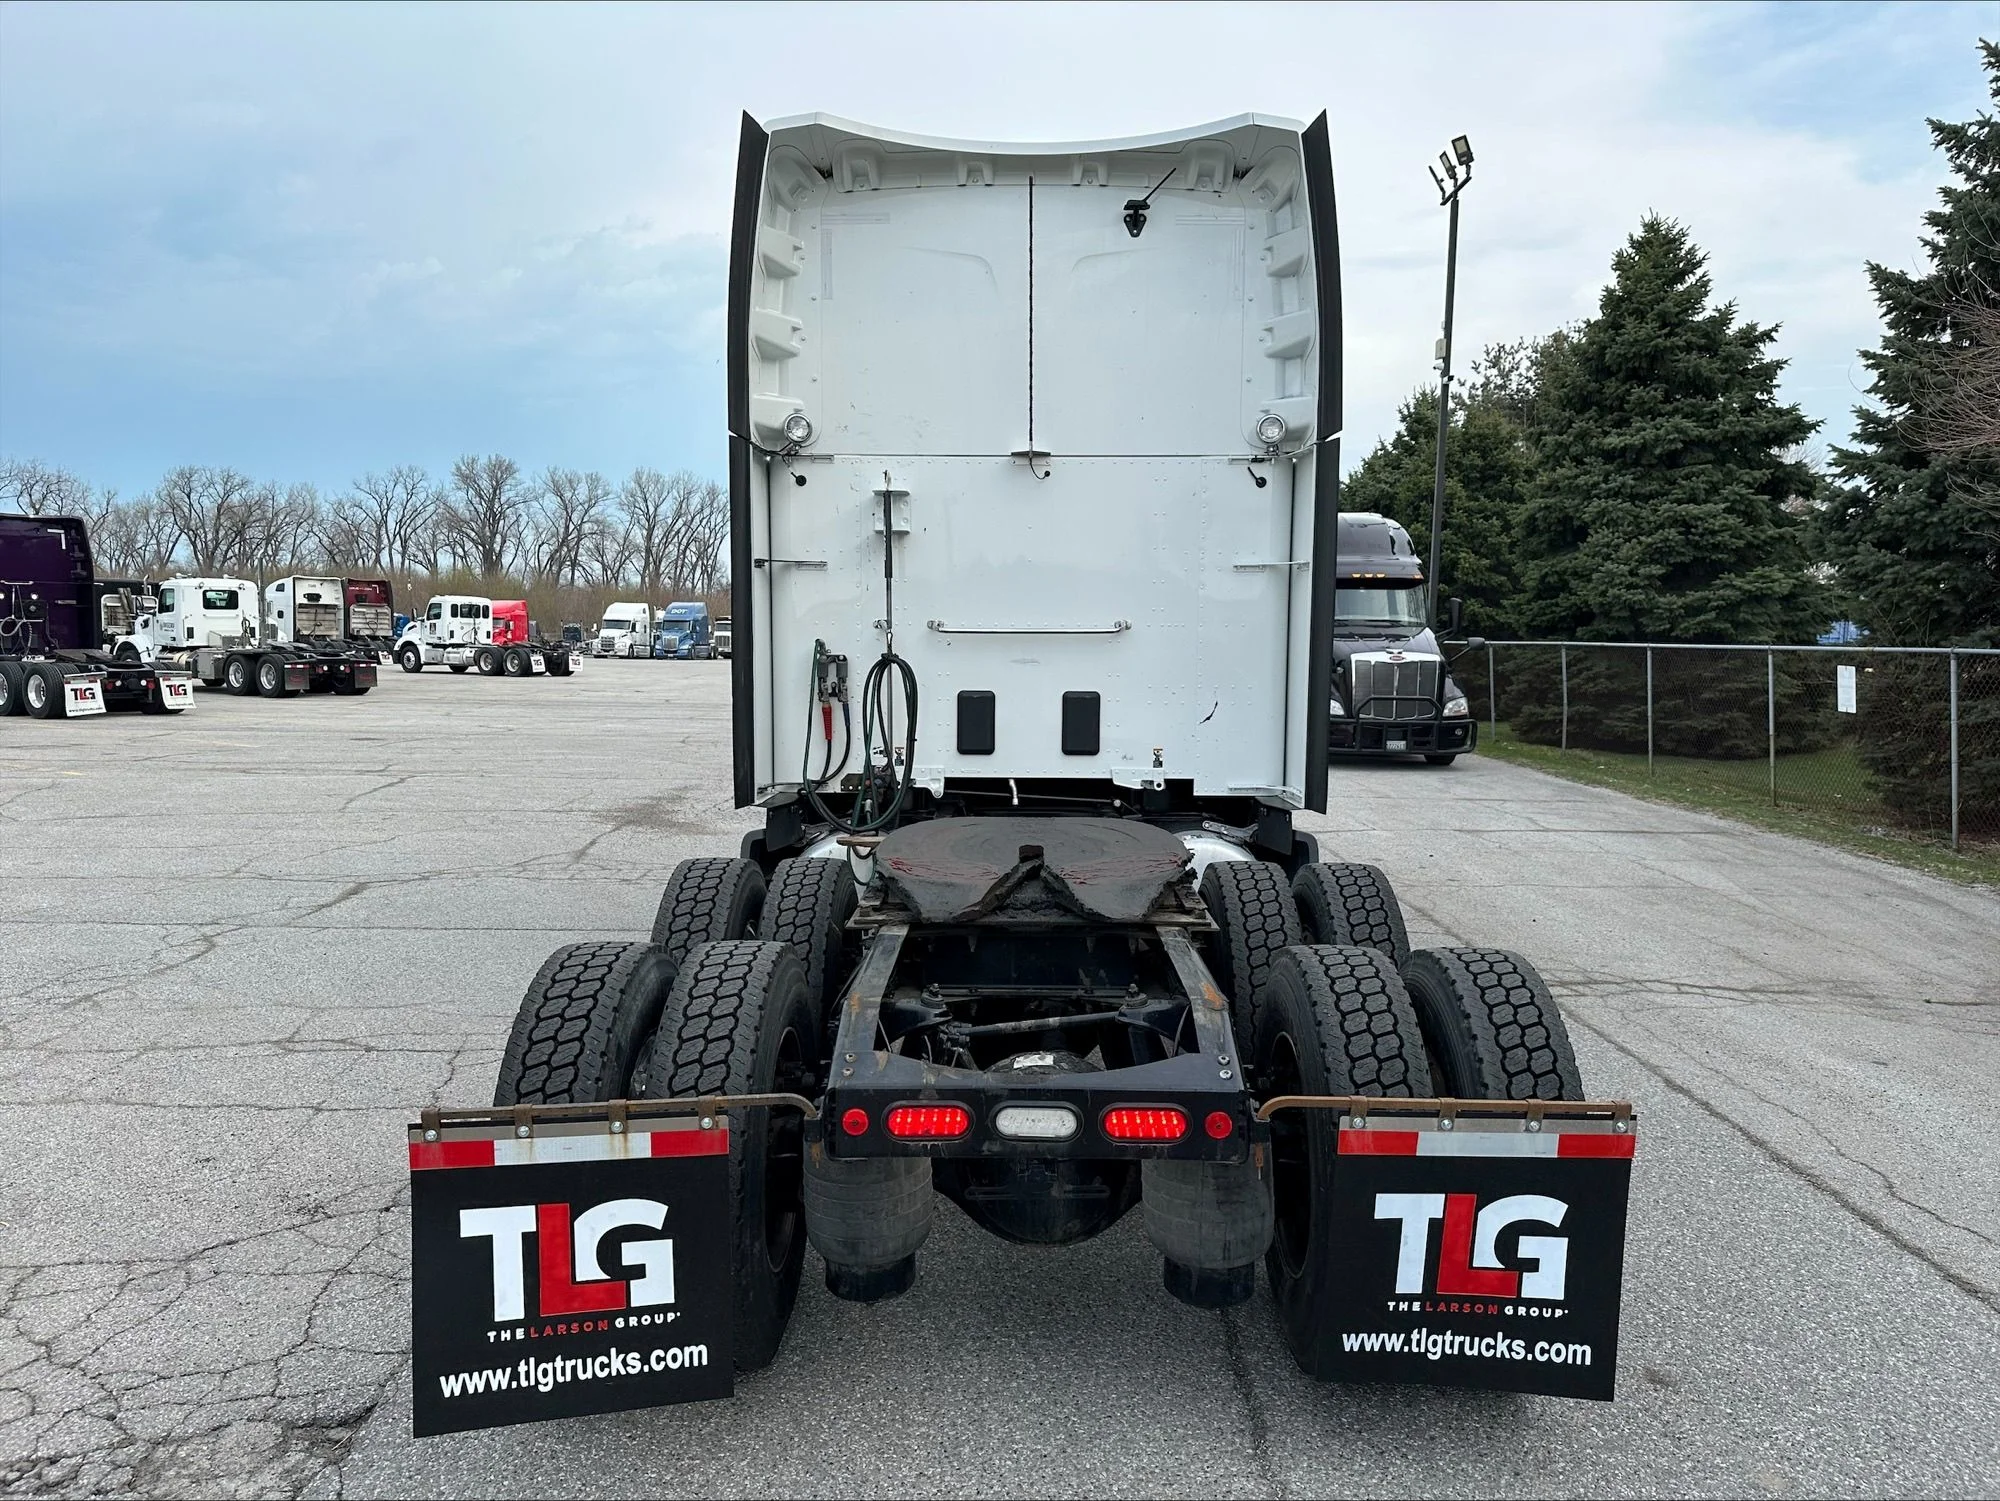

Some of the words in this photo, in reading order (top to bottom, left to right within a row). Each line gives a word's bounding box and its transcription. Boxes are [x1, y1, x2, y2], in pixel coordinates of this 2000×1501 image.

[70, 687, 96, 701] TLG
[165, 684, 188, 696] TLG
[459, 1198, 675, 1322] TLG
[1374, 1193, 1569, 1300] TLG
[487, 1327, 525, 1343] THE
[530, 1319, 609, 1339] LARSON
[614, 1311, 676, 1329] GROUP
[1387, 1301, 1421, 1312] THE
[1425, 1302, 1499, 1315] LARSON
[1504, 1305, 1564, 1318] GROUP
[1342, 1327, 1592, 1366] www.tlgtrucks.com
[439, 1343, 708, 1398] www.tlgtrucks.com
